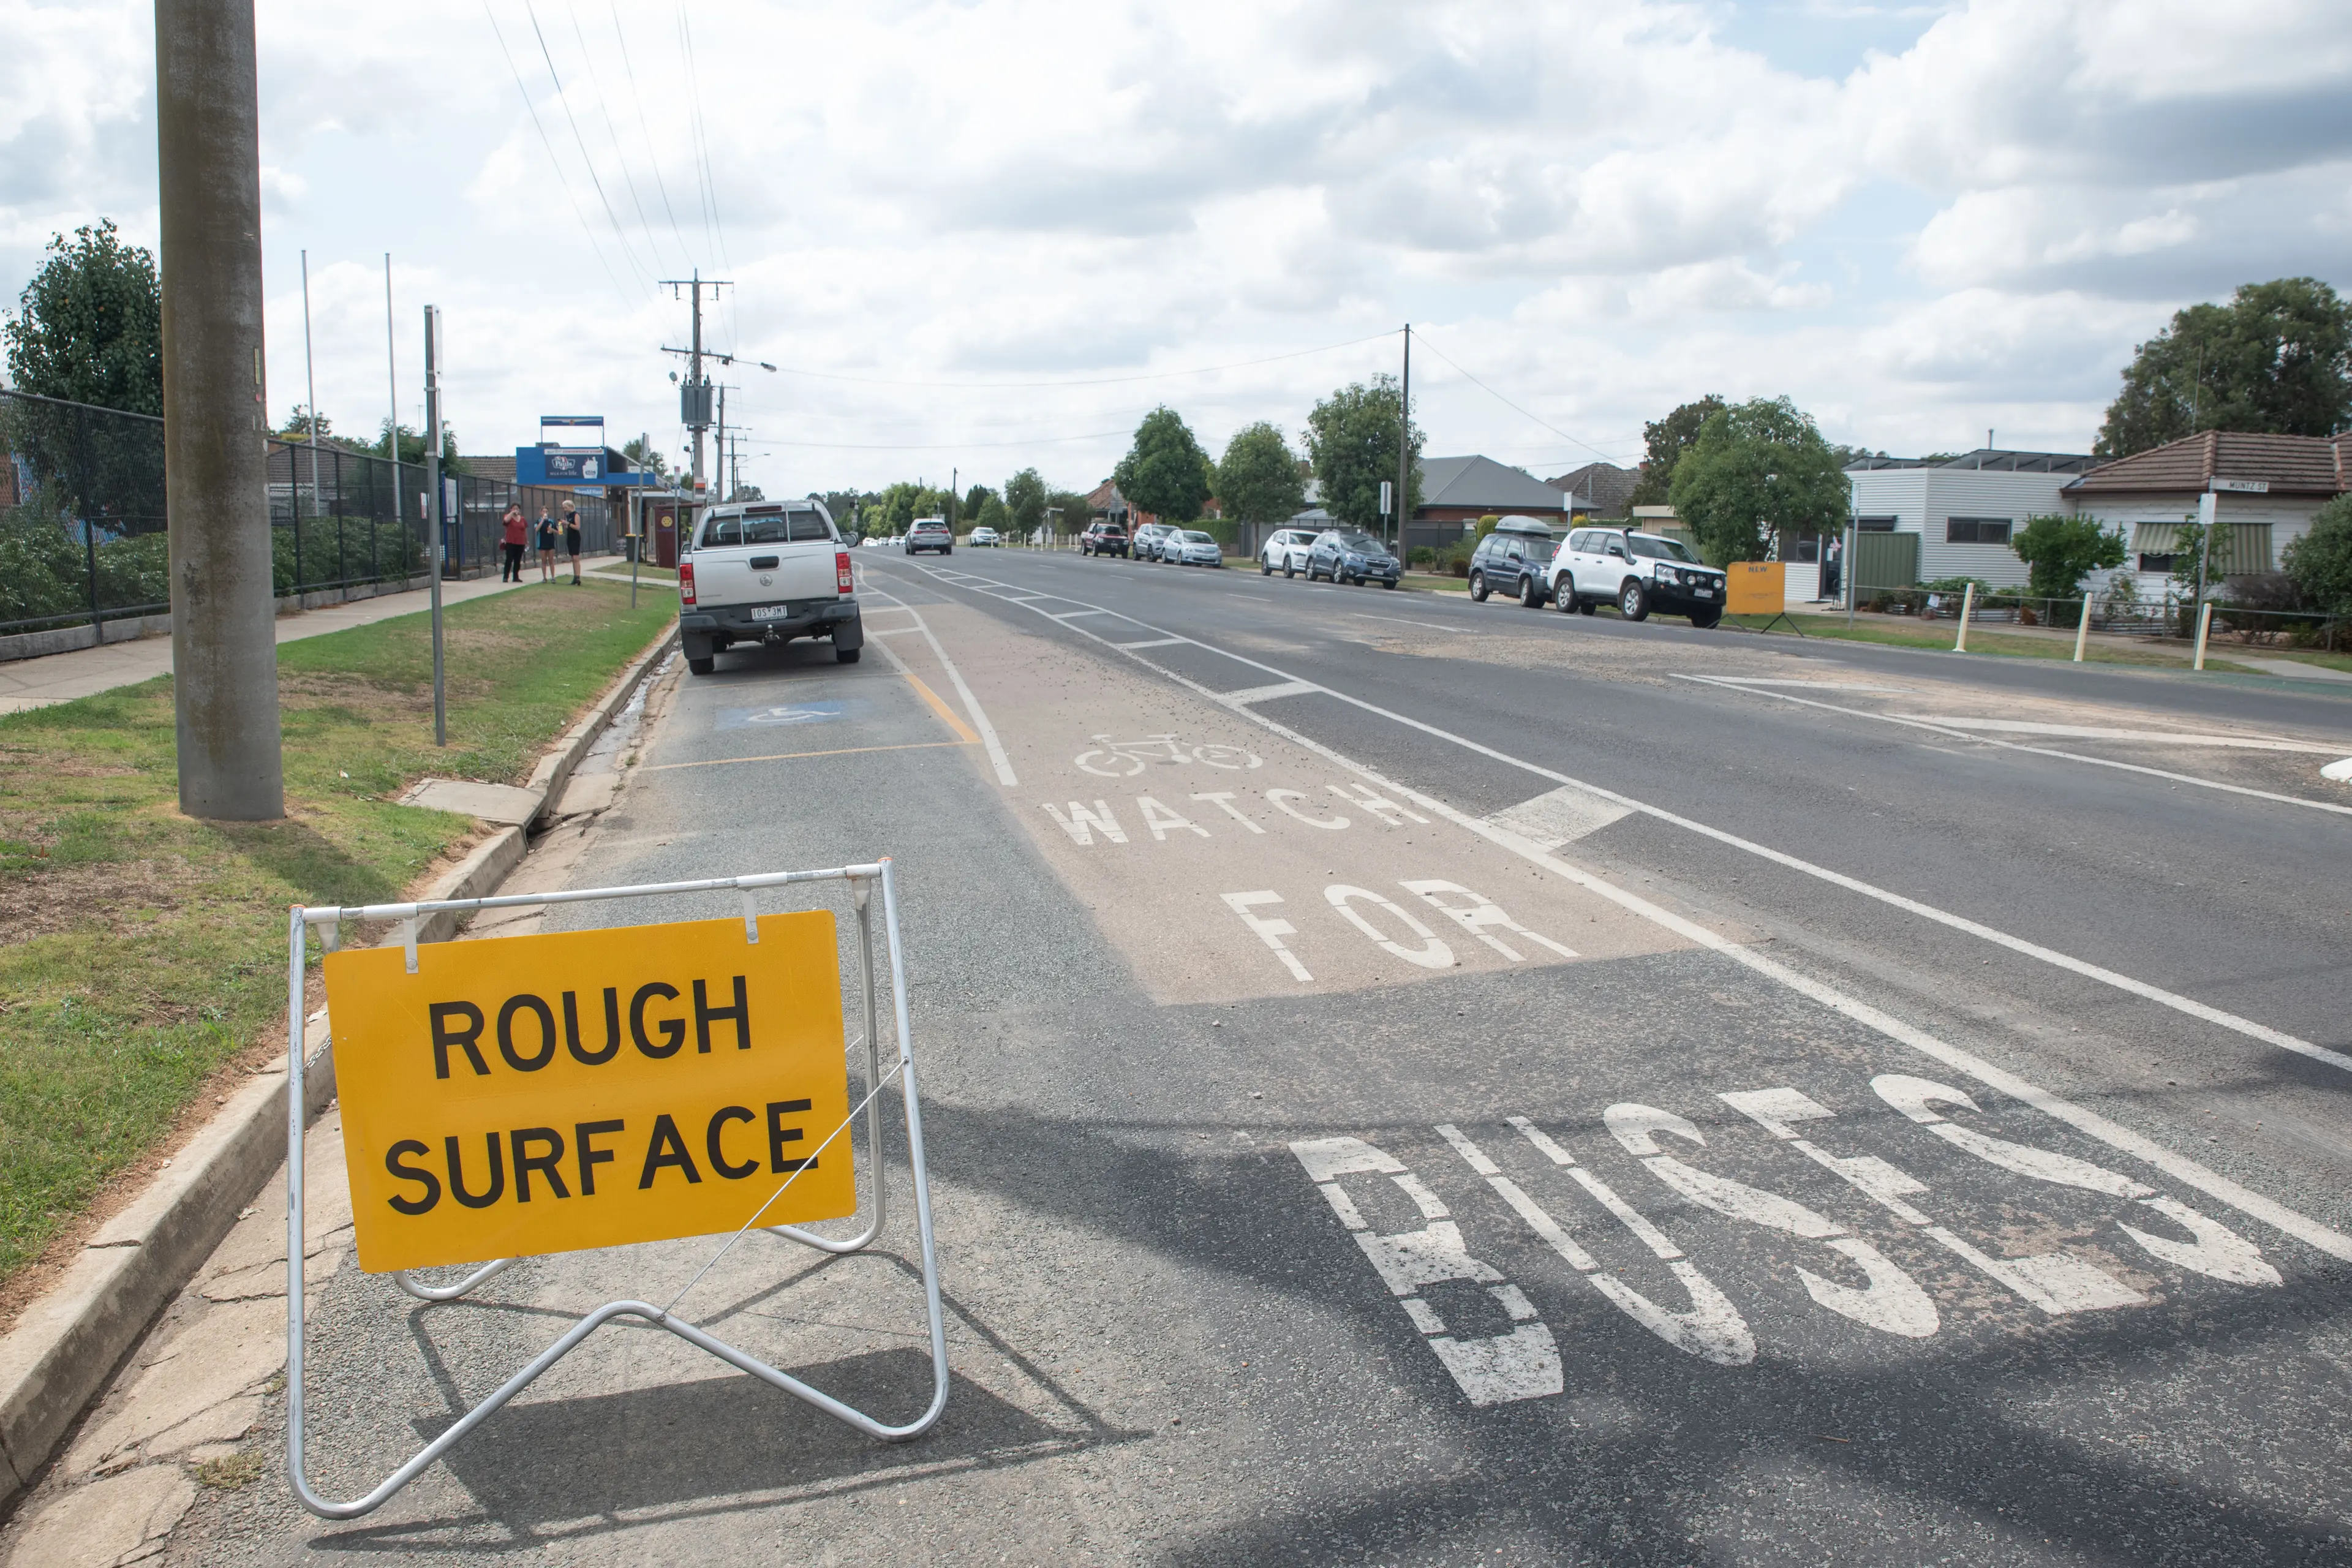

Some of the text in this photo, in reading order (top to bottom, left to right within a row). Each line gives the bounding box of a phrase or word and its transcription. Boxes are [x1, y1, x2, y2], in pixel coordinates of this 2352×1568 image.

[2229, 481, 2255, 490] MUNTZ
[1042, 783, 1430, 845] WATCH
[1219, 880, 1581, 981] FOR
[428, 975, 752, 1080] ROUGH
[385, 1098, 820, 1215] SURFACE
[1288, 1074, 2283, 1406] BUSES
